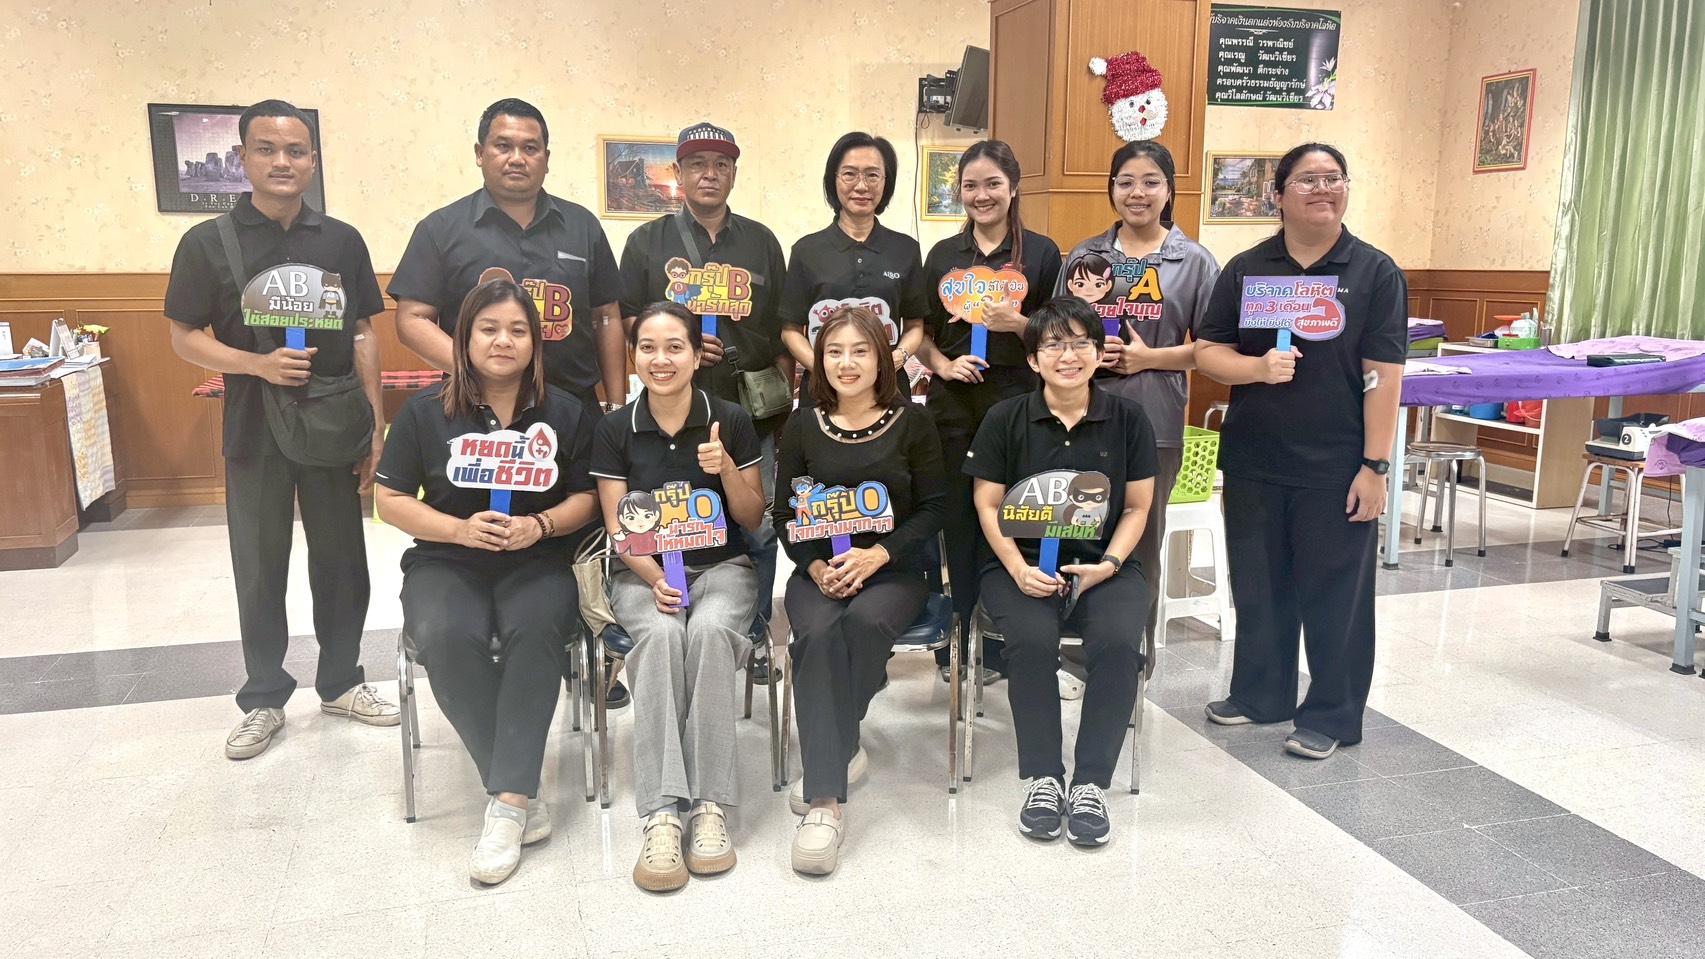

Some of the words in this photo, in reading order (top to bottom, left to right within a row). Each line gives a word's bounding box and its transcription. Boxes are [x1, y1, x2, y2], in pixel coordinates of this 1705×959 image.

[688, 264, 730, 293] กรุ๊ป
[729, 269, 750, 301] B
[1112, 258, 1148, 282] กรุ๊ป
[262, 269, 309, 297] AB
[1128, 267, 1163, 301] A
[1245, 281, 1335, 298] บริจาคโลหิต
[268, 296, 314, 312] มีน้อย
[544, 285, 571, 321] B
[1093, 296, 1162, 321] วยใจบุญ
[1245, 302, 1264, 317] ทุก
[1264, 301, 1277, 315] 3
[1279, 299, 1312, 314] เดือน
[1297, 317, 1340, 330] สุขภาพดี
[460, 435, 531, 460] หยดนี้
[1623, 434, 1631, 444] 2
[452, 458, 554, 487] เพื่อชีวิต
[653, 482, 692, 506] กรุ๊ป
[687, 488, 721, 524] O
[812, 490, 857, 519] กรุ๊ป
[855, 481, 889, 517] O
[1018, 476, 1069, 506] AB
[1003, 504, 1054, 521] นิสัยดี
[655, 523, 727, 552] ให้หมดใจ
[668, 519, 706, 533] น่ารัก
[1044, 521, 1100, 538] มีเสน่ห์
